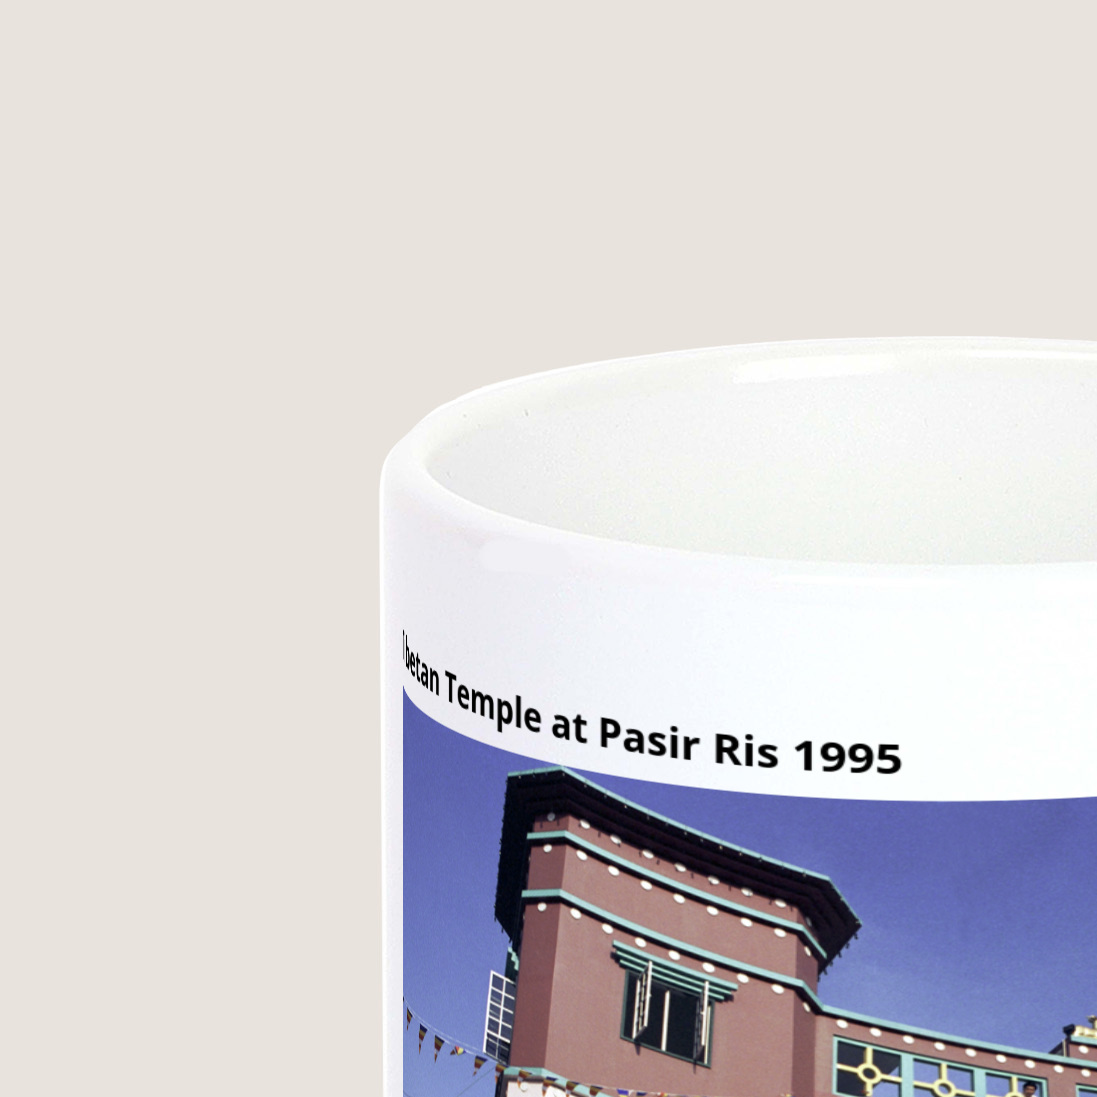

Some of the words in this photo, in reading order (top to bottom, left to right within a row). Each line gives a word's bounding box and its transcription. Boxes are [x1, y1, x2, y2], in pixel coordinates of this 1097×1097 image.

[445, 670, 542, 733] Temple
[552, 714, 588, 744] at
[600, 717, 700, 762] Pasir
[715, 733, 779, 769] Ris
[795, 740, 902, 775] 1995
